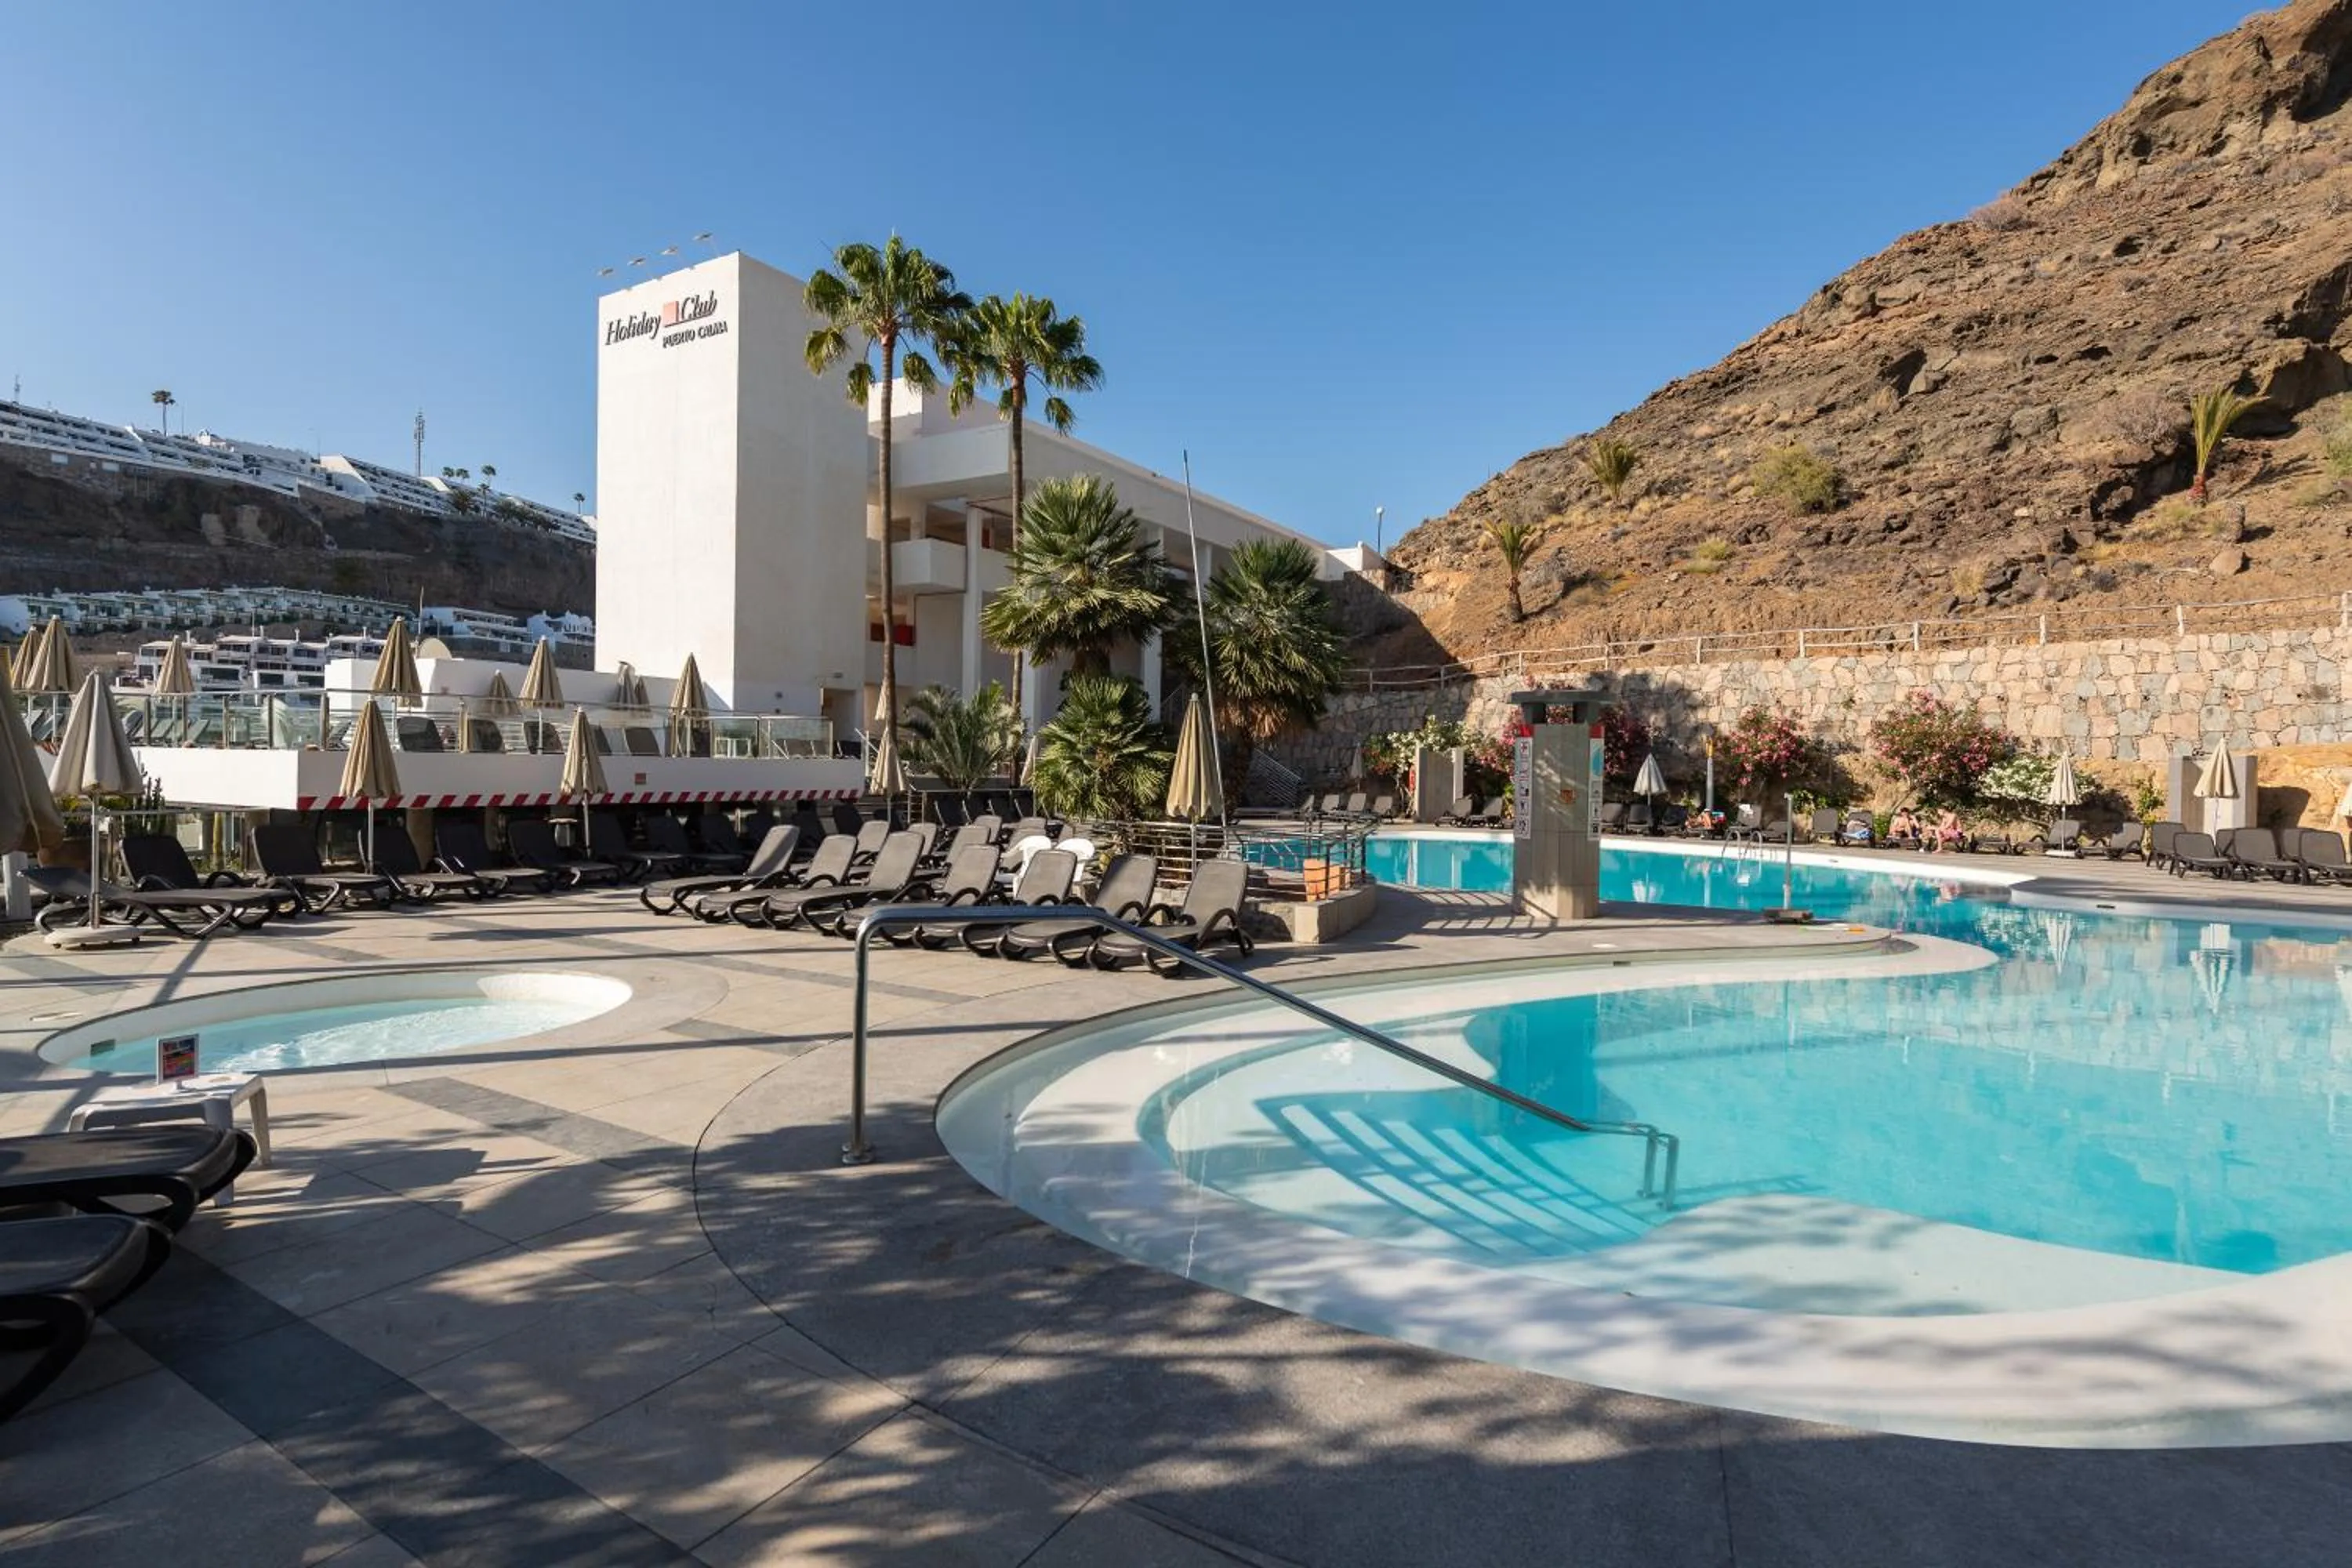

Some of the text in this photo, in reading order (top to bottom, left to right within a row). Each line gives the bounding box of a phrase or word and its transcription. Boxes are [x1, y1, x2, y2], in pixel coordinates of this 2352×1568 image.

[605, 289, 717, 345] Holiday Club
[662, 329, 695, 349] PUERTO
